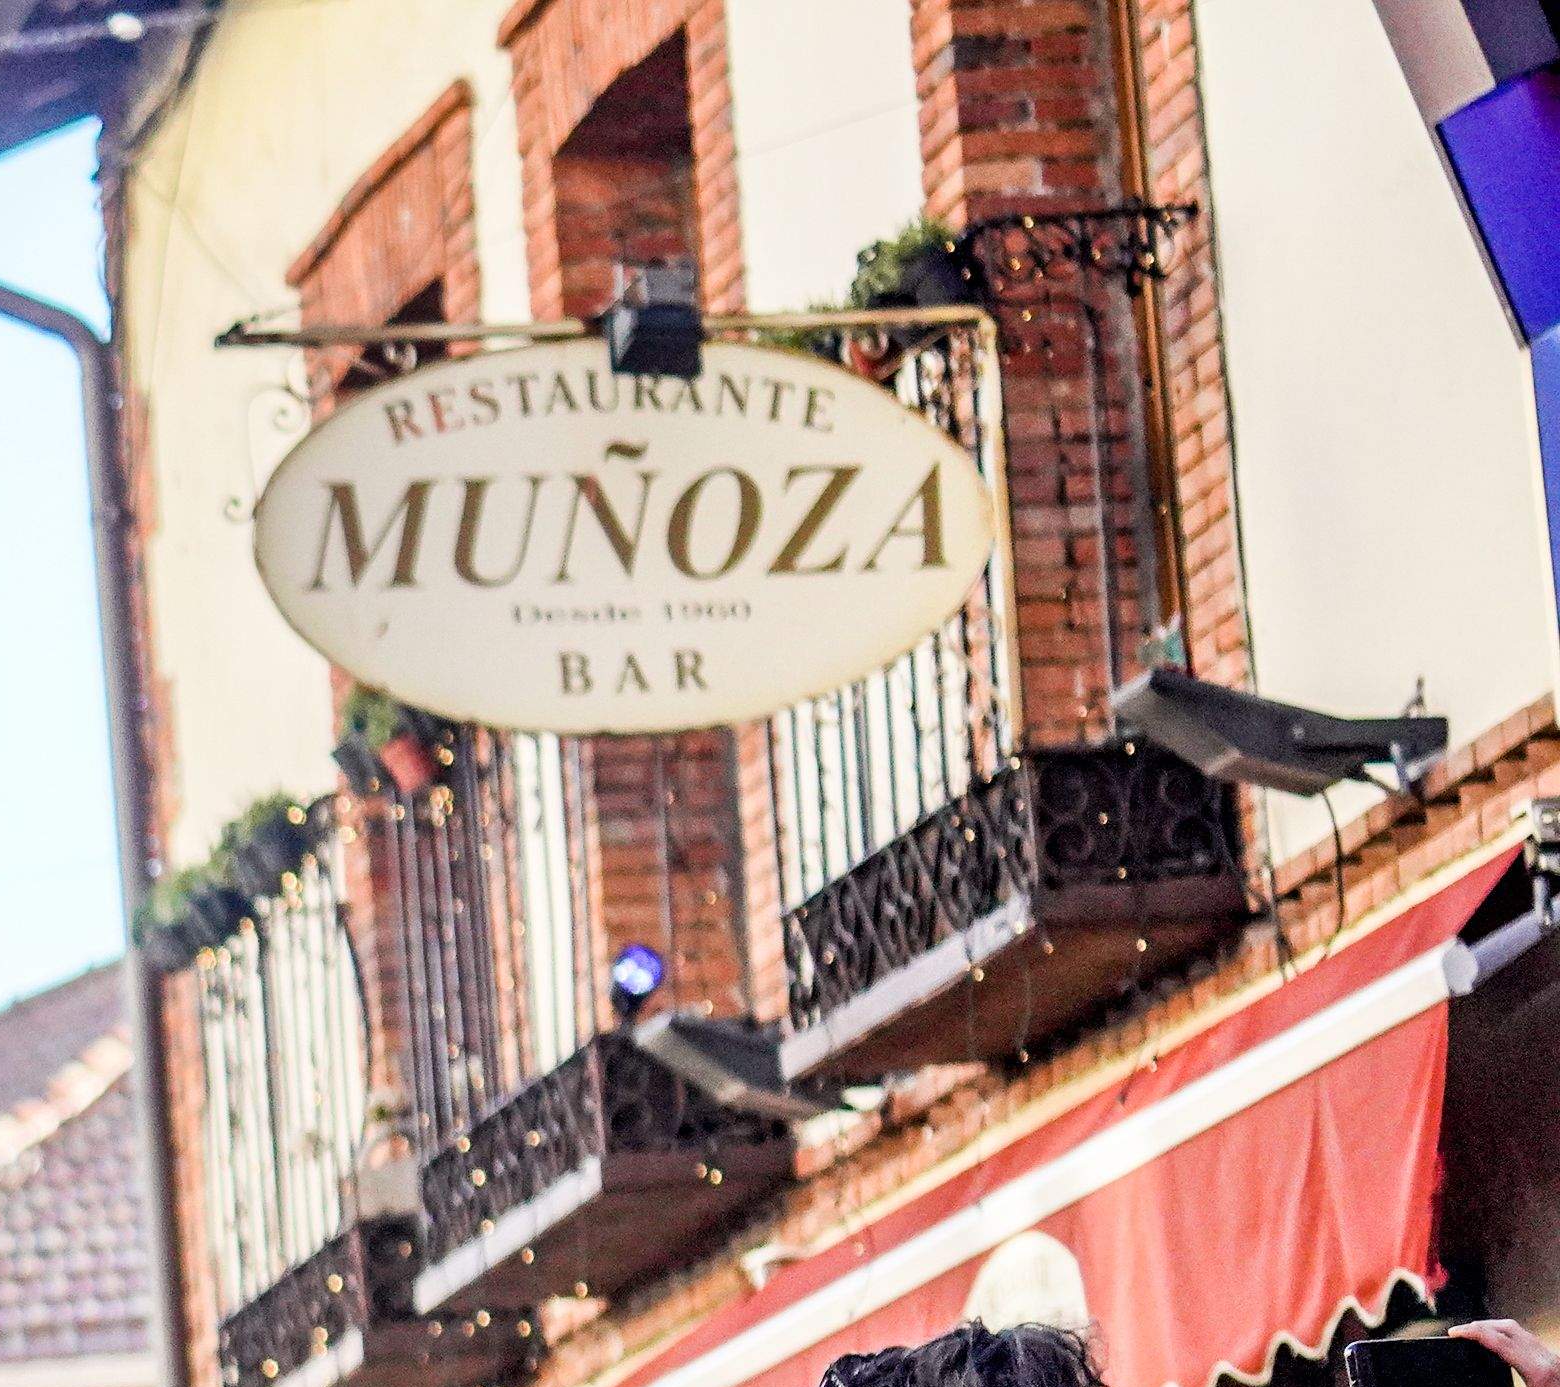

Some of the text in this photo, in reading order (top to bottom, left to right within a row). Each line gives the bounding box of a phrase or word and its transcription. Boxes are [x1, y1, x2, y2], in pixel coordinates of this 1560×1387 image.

[384, 371, 836, 445] RESTAURANTE
[308, 440, 951, 592] MUÑOZA
[559, 648, 709, 695] BAR
